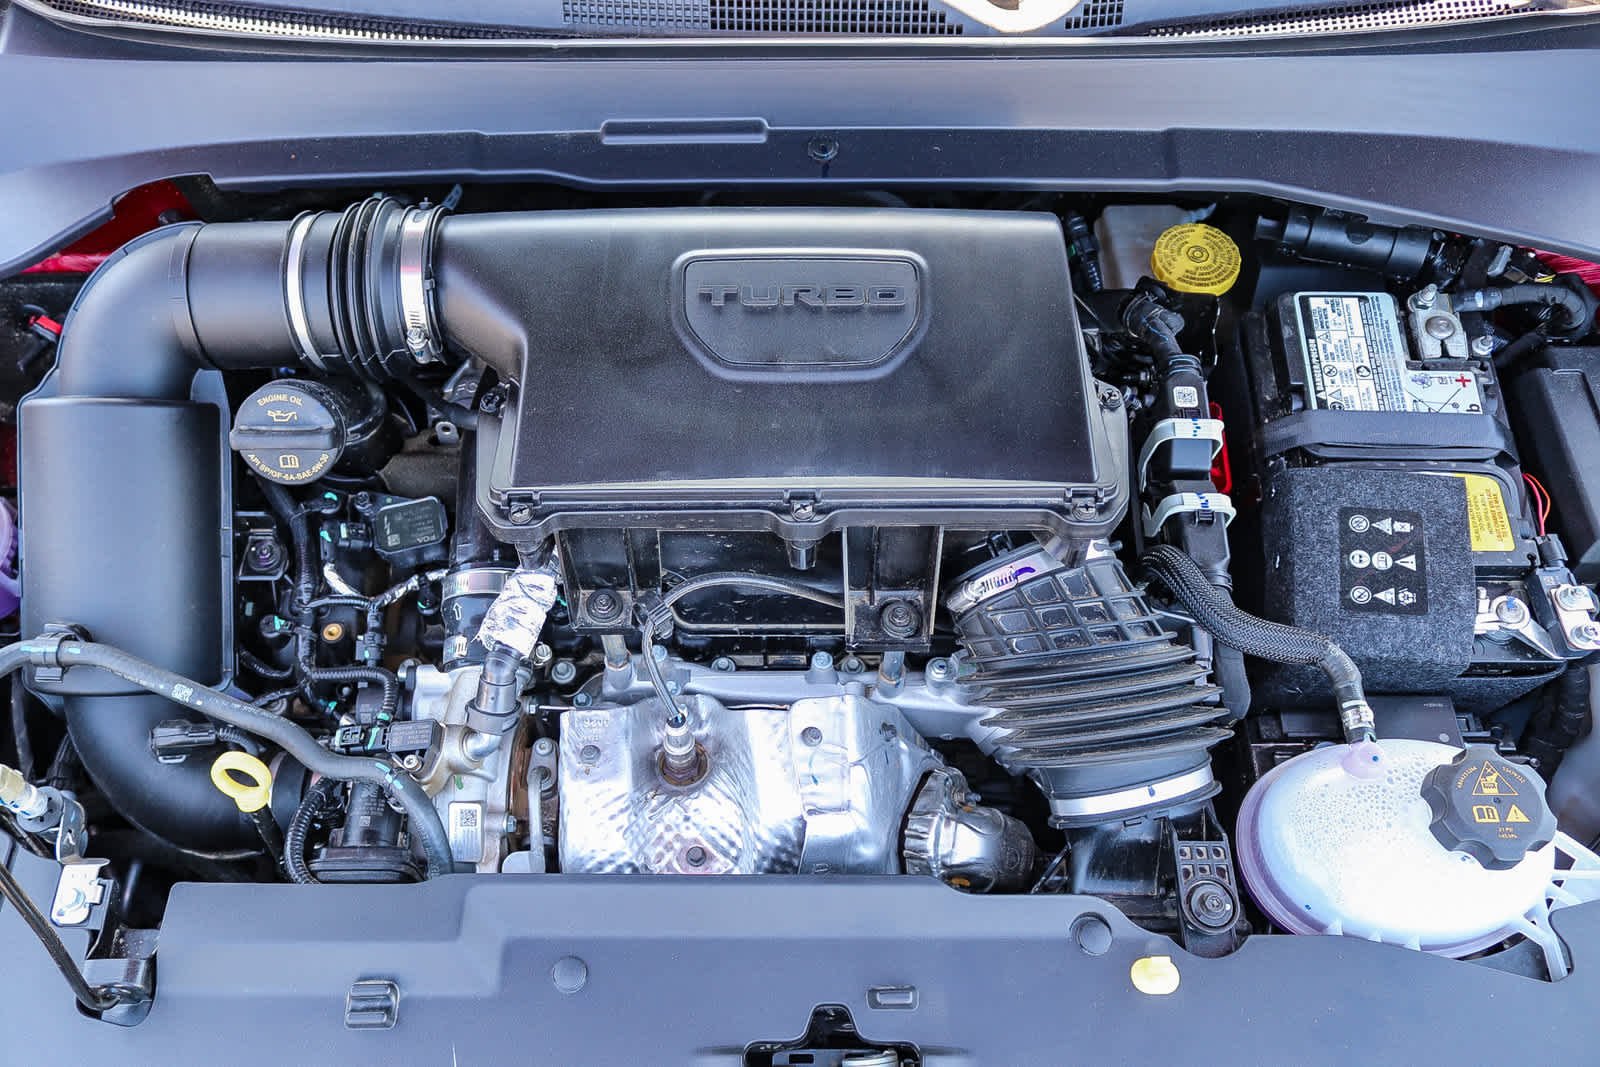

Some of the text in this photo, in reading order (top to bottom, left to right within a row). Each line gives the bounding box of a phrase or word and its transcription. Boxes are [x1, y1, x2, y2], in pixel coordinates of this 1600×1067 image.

[698, 283, 906, 306] TURBO
[257, 394, 303, 407] ENGINE OIL
[248, 453, 260, 466] API
